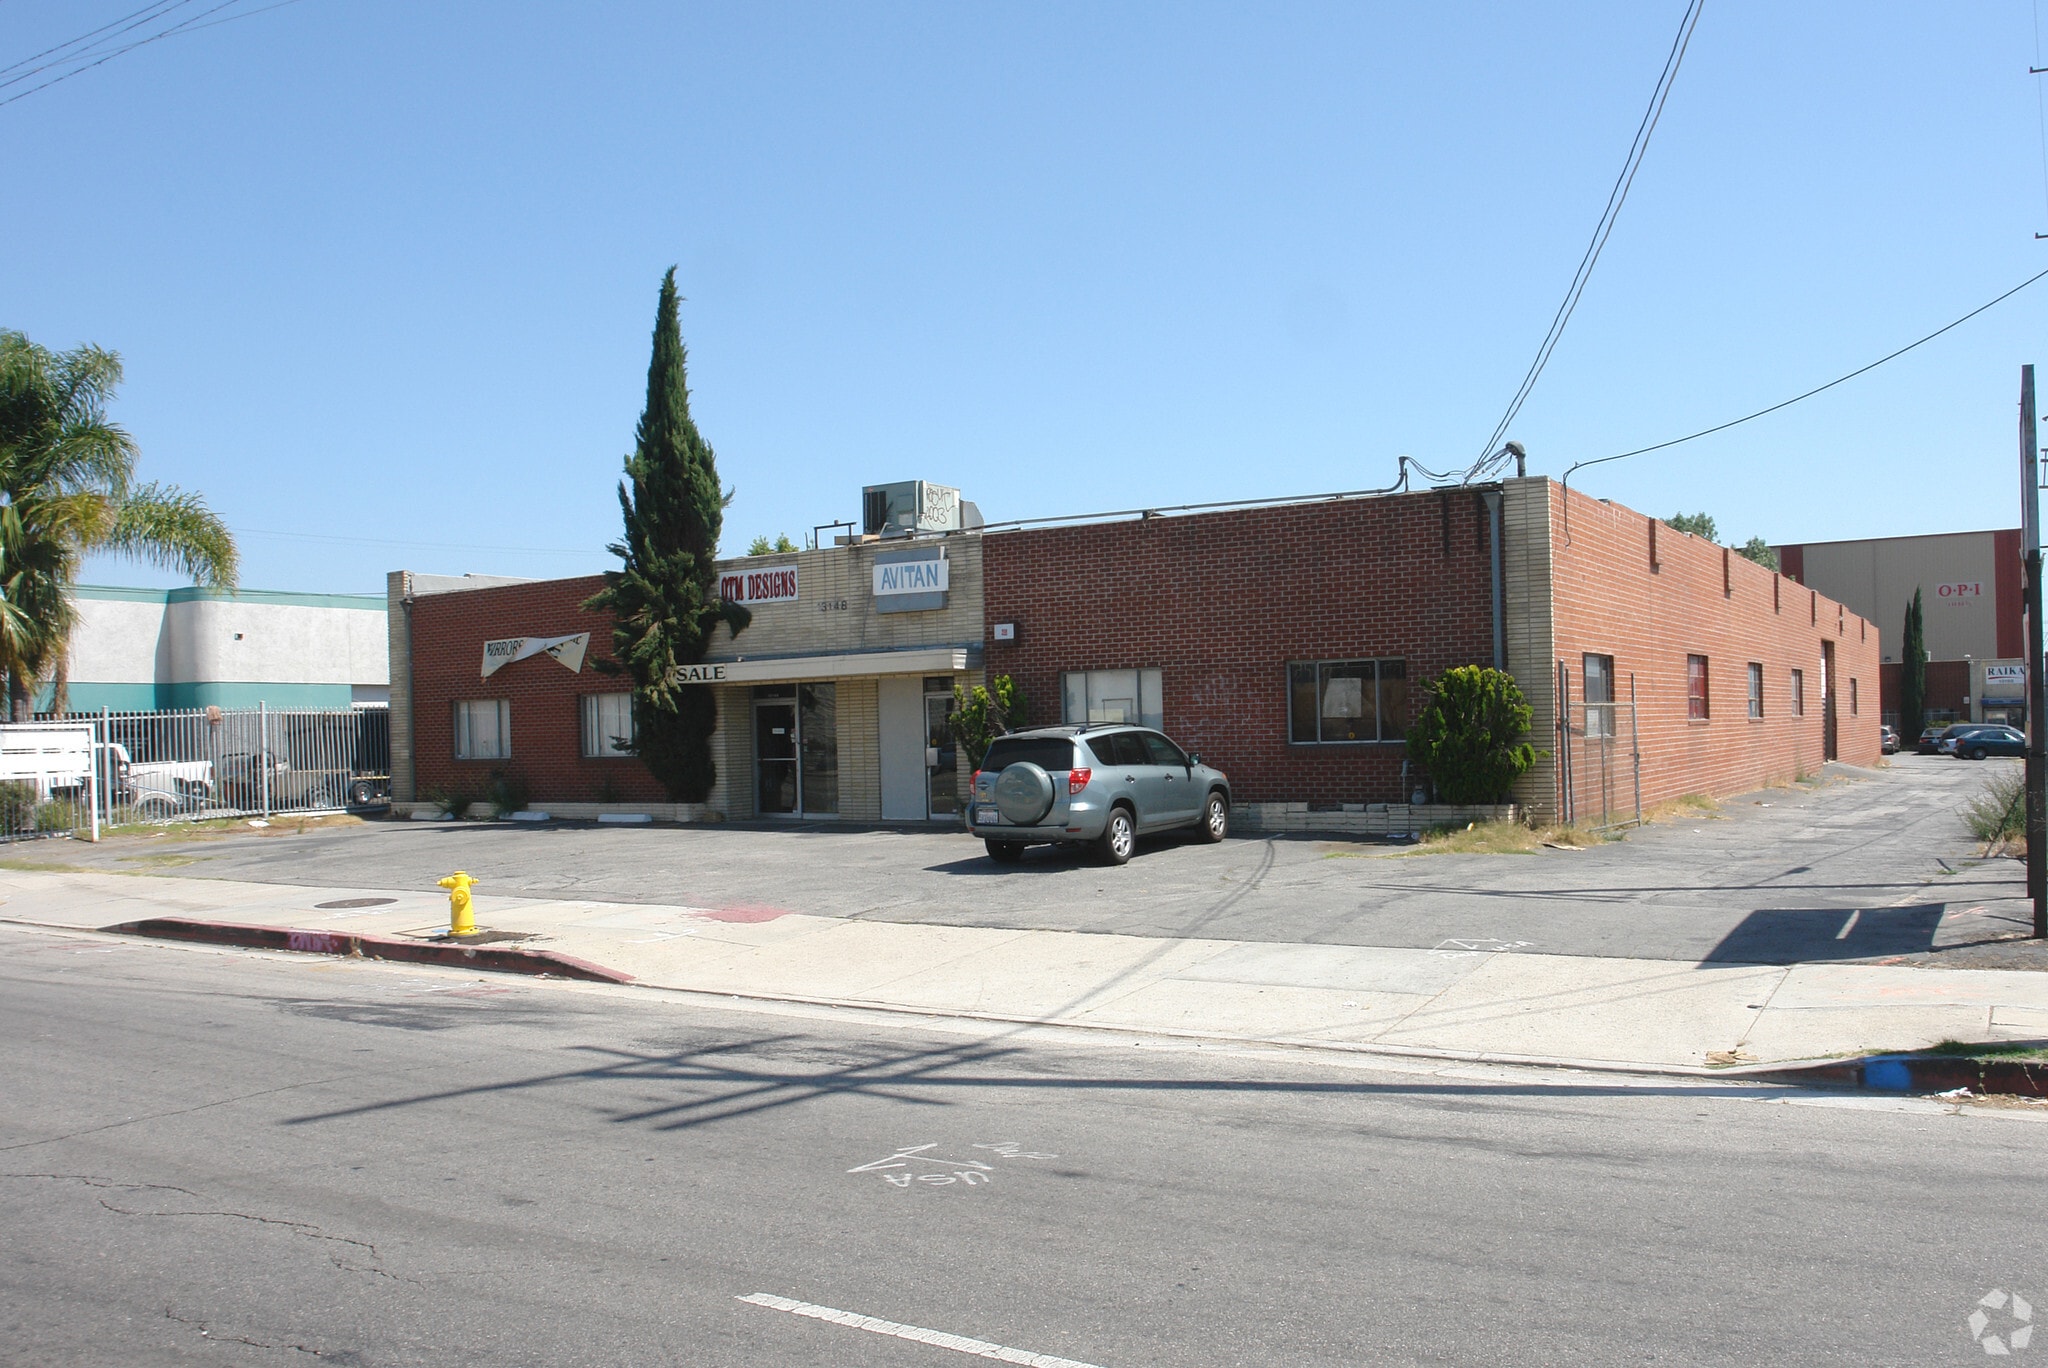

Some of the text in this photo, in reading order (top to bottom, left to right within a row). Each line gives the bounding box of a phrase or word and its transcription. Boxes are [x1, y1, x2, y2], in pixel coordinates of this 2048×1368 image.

[748, 570, 797, 600] DESIGNS
[881, 563, 939, 590] AVITAN
[676, 665, 727, 682] SALE
